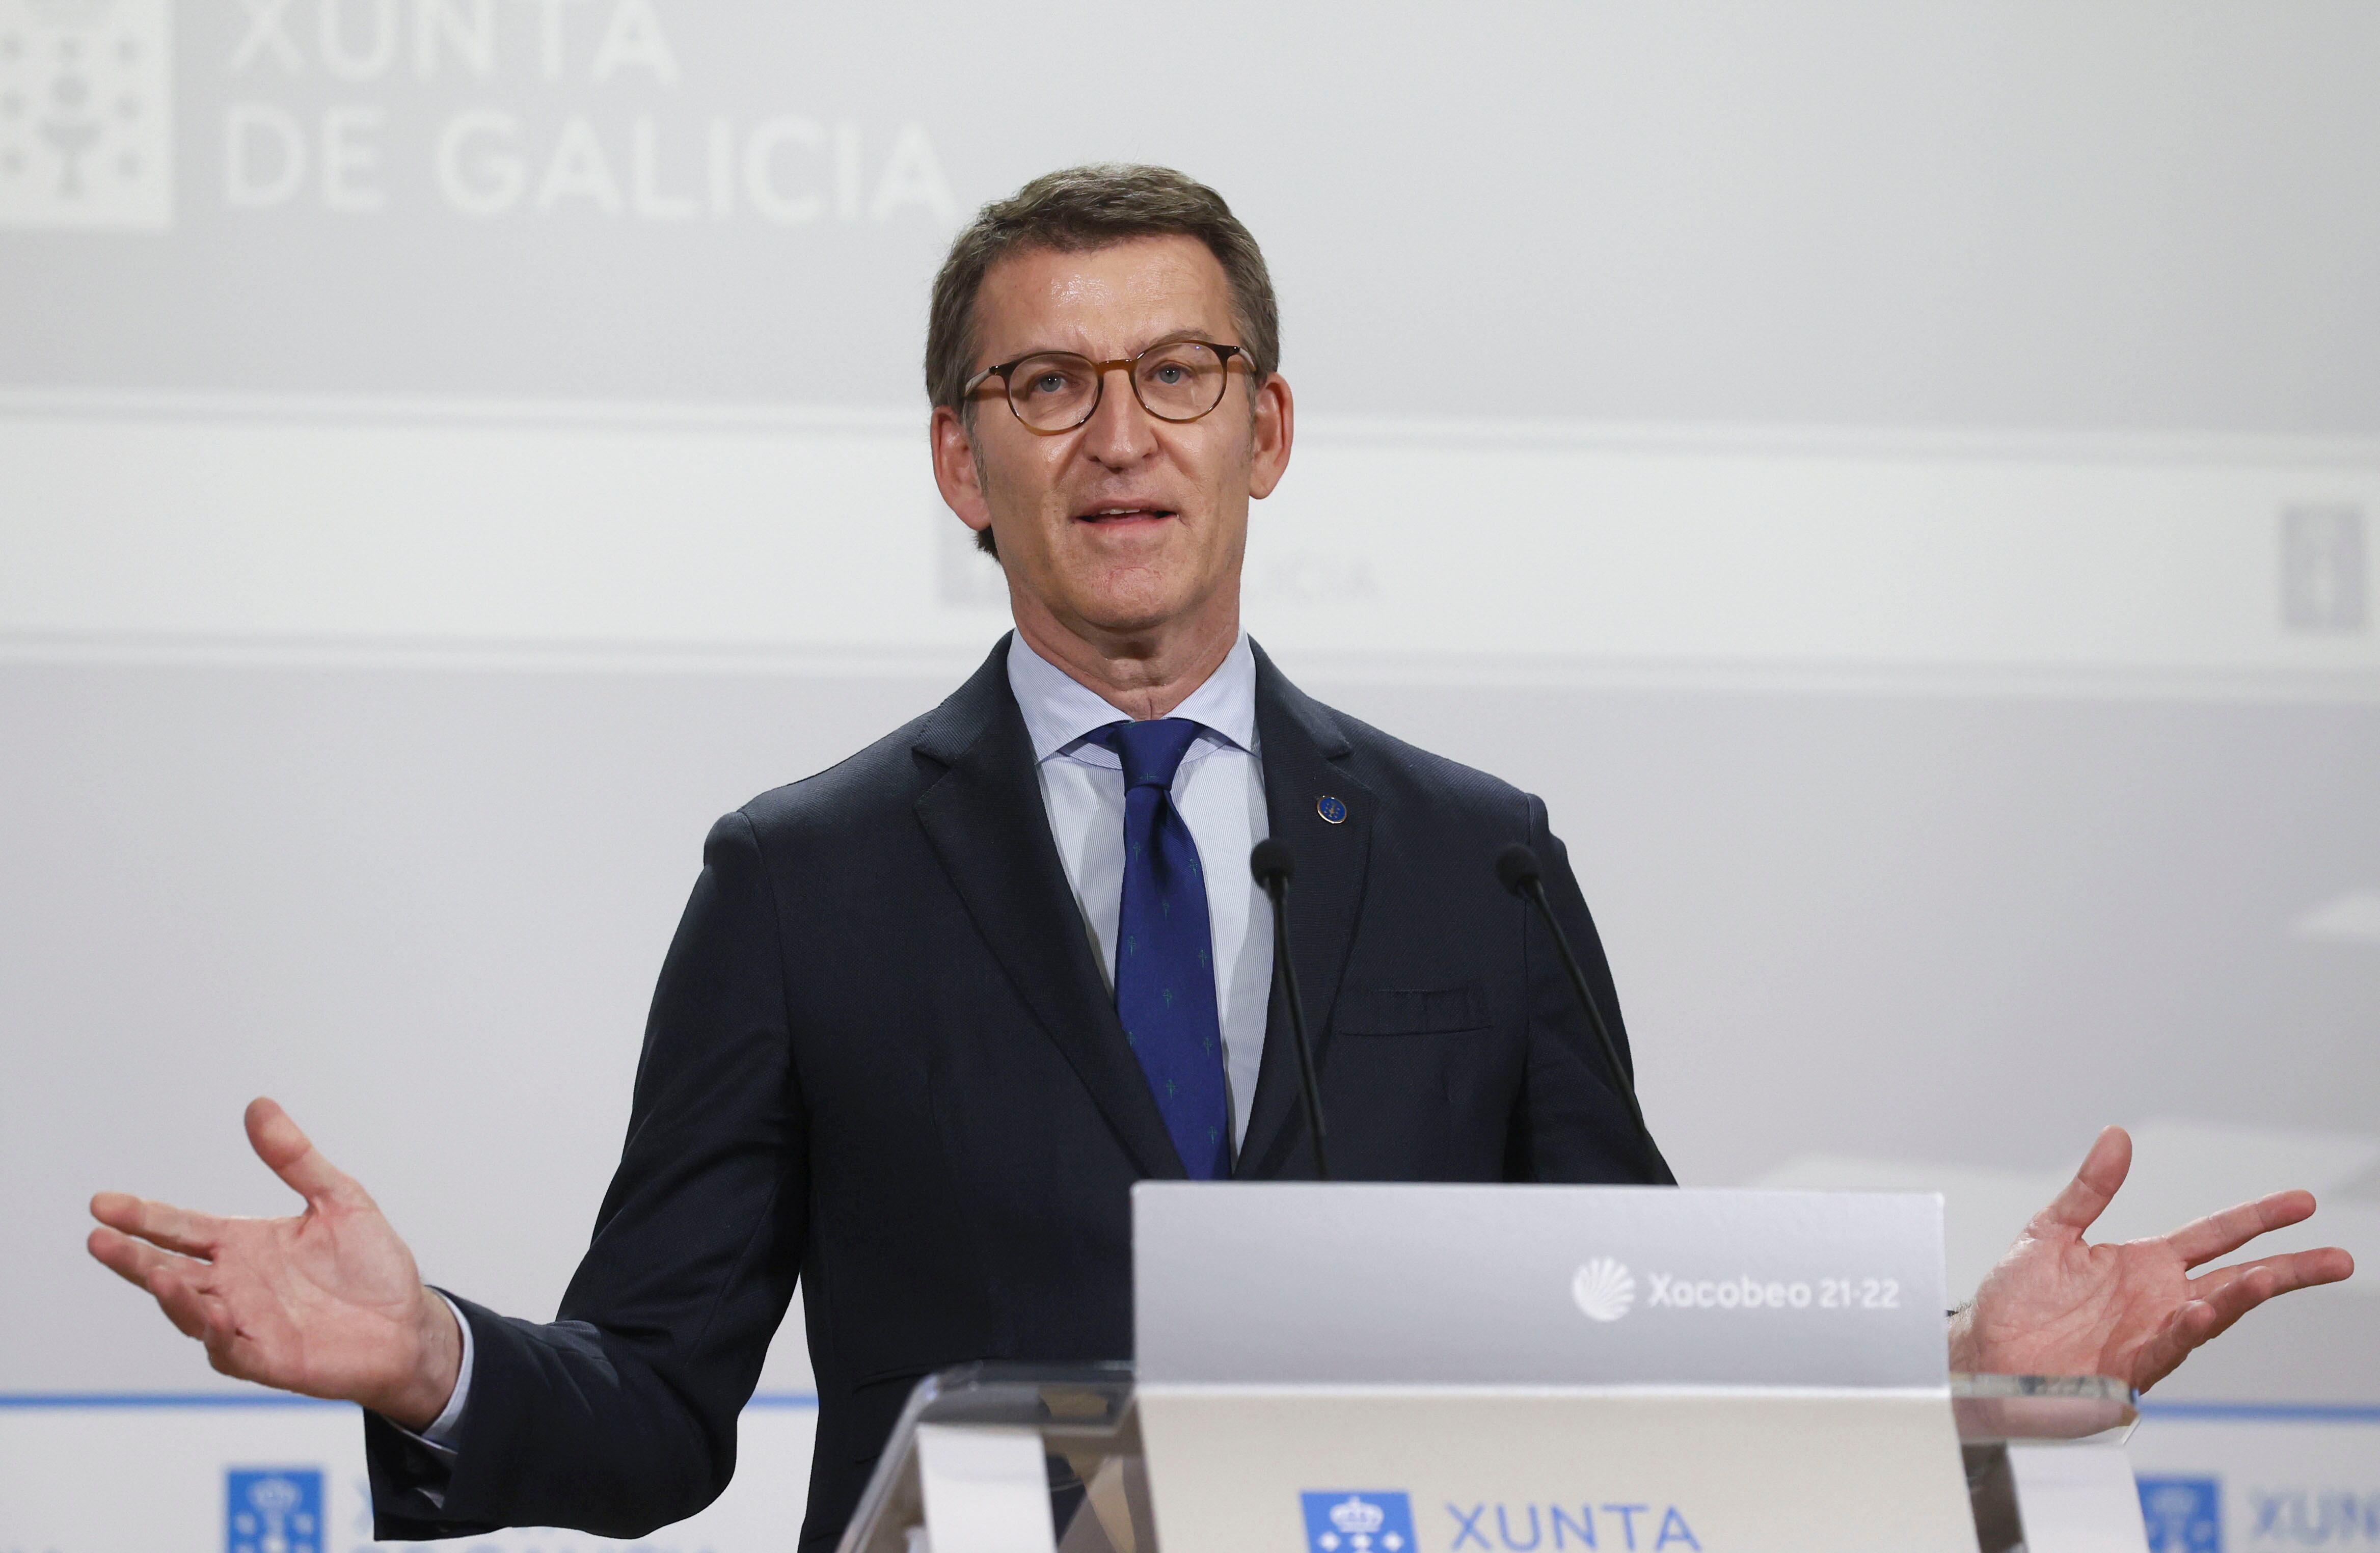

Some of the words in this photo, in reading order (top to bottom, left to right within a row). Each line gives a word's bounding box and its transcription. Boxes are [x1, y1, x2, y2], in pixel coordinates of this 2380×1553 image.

[228, 0, 681, 86] XUNTA
[224, 103, 386, 211] DE
[434, 107, 958, 224] GALICIA
[1647, 1272, 1811, 1308] Xacobeo
[1446, 1503, 1702, 1551] XUNTA
